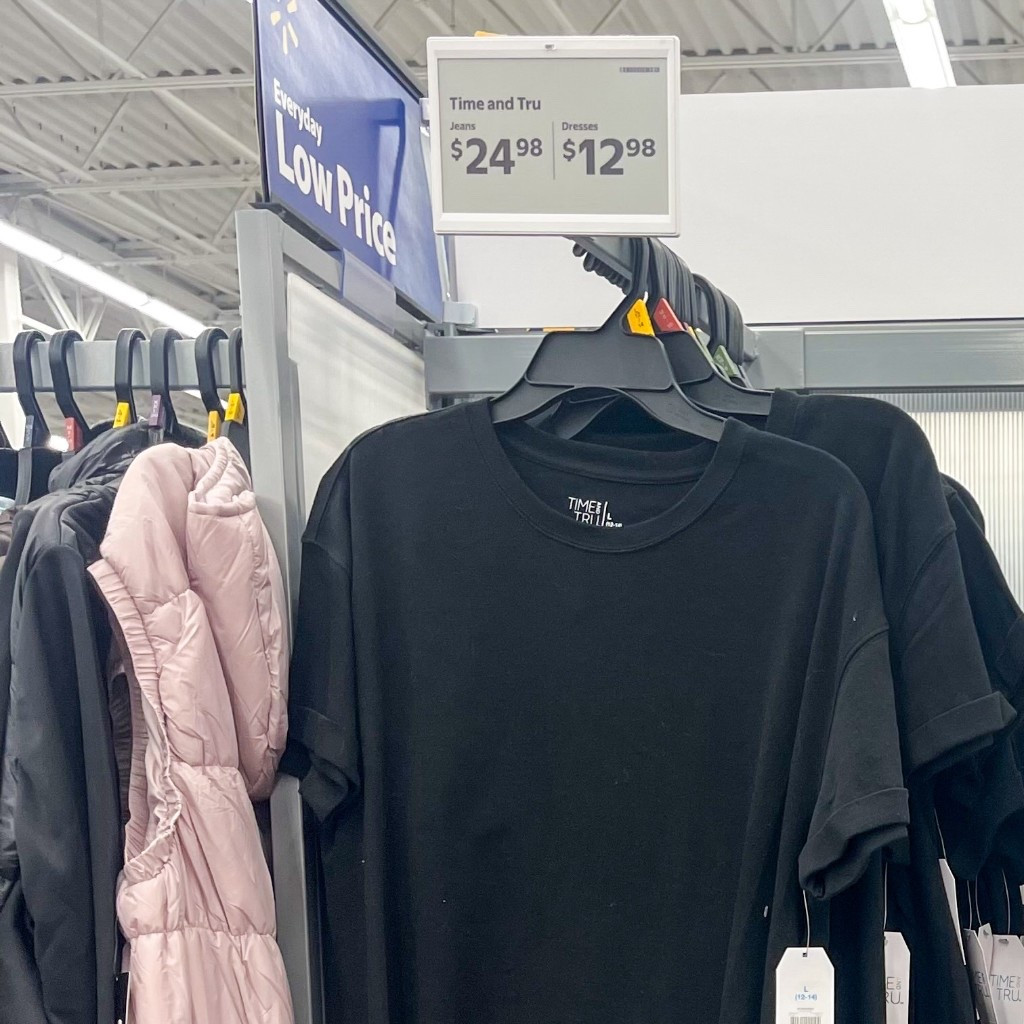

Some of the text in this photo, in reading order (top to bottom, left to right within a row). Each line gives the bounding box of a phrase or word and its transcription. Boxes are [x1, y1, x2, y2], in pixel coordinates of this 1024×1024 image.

[450, 97, 542, 111] Time and Tru
[272, 76, 323, 147] Everyday
[450, 122, 476, 132] Jeans
[561, 122, 599, 132] Dresses
[275, 109, 397, 266] Low Price
[568, 497, 596, 513] TIME
[607, 512, 612, 521] L
[990, 974, 1016, 989] TIME
[997, 988, 1020, 1002] TRU
